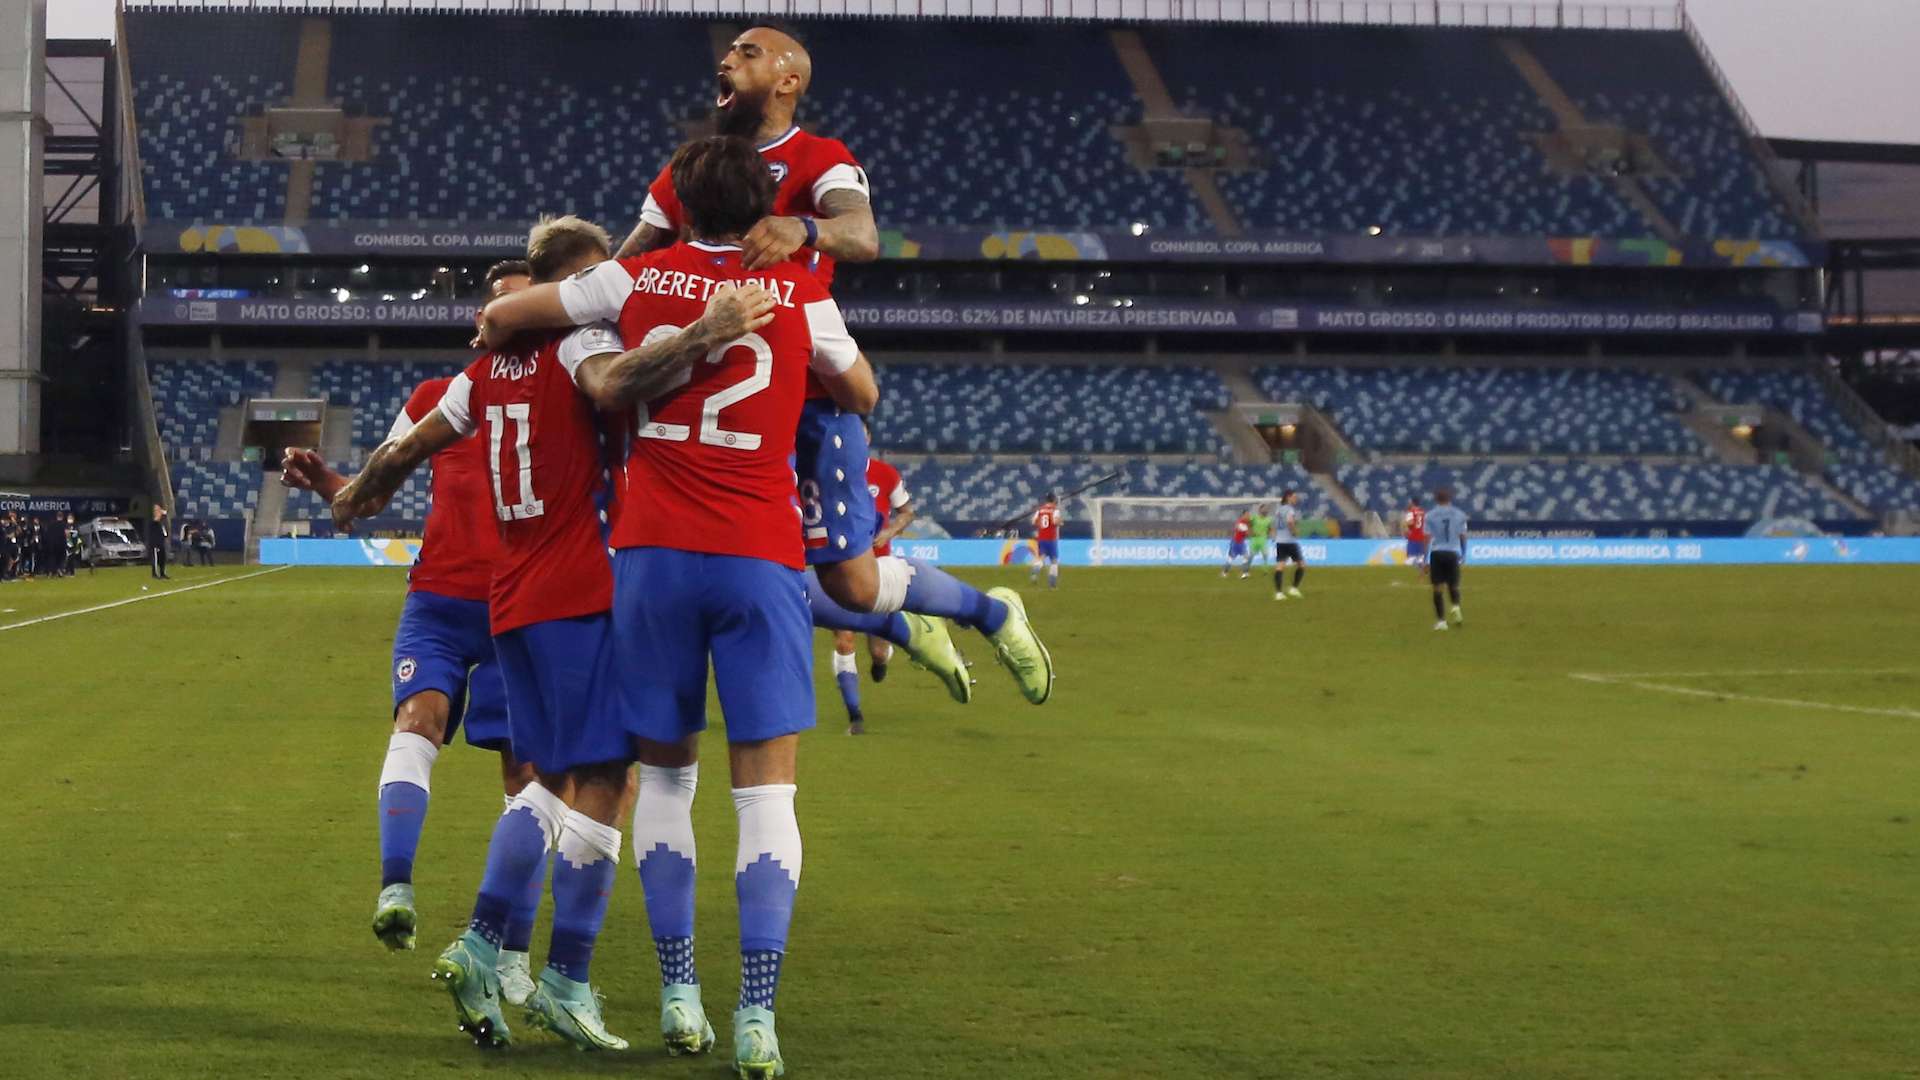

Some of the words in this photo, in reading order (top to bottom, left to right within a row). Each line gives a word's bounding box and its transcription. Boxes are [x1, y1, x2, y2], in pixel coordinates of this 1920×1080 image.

[354, 234, 428, 247] CONMEBOL
[432, 234, 470, 247] COPA
[474, 234, 528, 247] AMERIC
[1150, 240, 1221, 254] CONMEBOL
[1225, 241, 1260, 254] COPA
[1264, 241, 1324, 255] AMERICA
[241, 304, 290, 319] MATO
[294, 304, 371, 320] GROSSO:
[375, 305, 387, 320] O
[391, 305, 449, 320] MAIOR
[884, 309, 959, 323] GROSSO:
[962, 309, 1000, 324] 62%
[1002, 309, 1025, 324] DE
[1029, 309, 1120, 325] NATUREZA
[1123, 310, 1237, 326] PRESERVADA
[1318, 312, 1365, 327] MATO
[1445, 312, 1456, 327] O
[1460, 312, 1512, 328] MAIOR
[1516, 312, 1602, 328] PRODUTOR
[1607, 313, 1629, 328] DO
[1633, 313, 1677, 329] AGRO
[1680, 314, 1773, 329] BRASILEIRO
[486, 404, 544, 521] 11
[1, 501, 26, 511] COPA
[28, 502, 71, 511] AMERICA
[1042, 515, 1049, 528] 6
[912, 546, 938, 560] 2021
[1181, 546, 1223, 560] COPA
[1471, 545, 1556, 560] CONMEBOL
[1559, 545, 1600, 560] COPA
[1603, 545, 1671, 560] AMERICA
